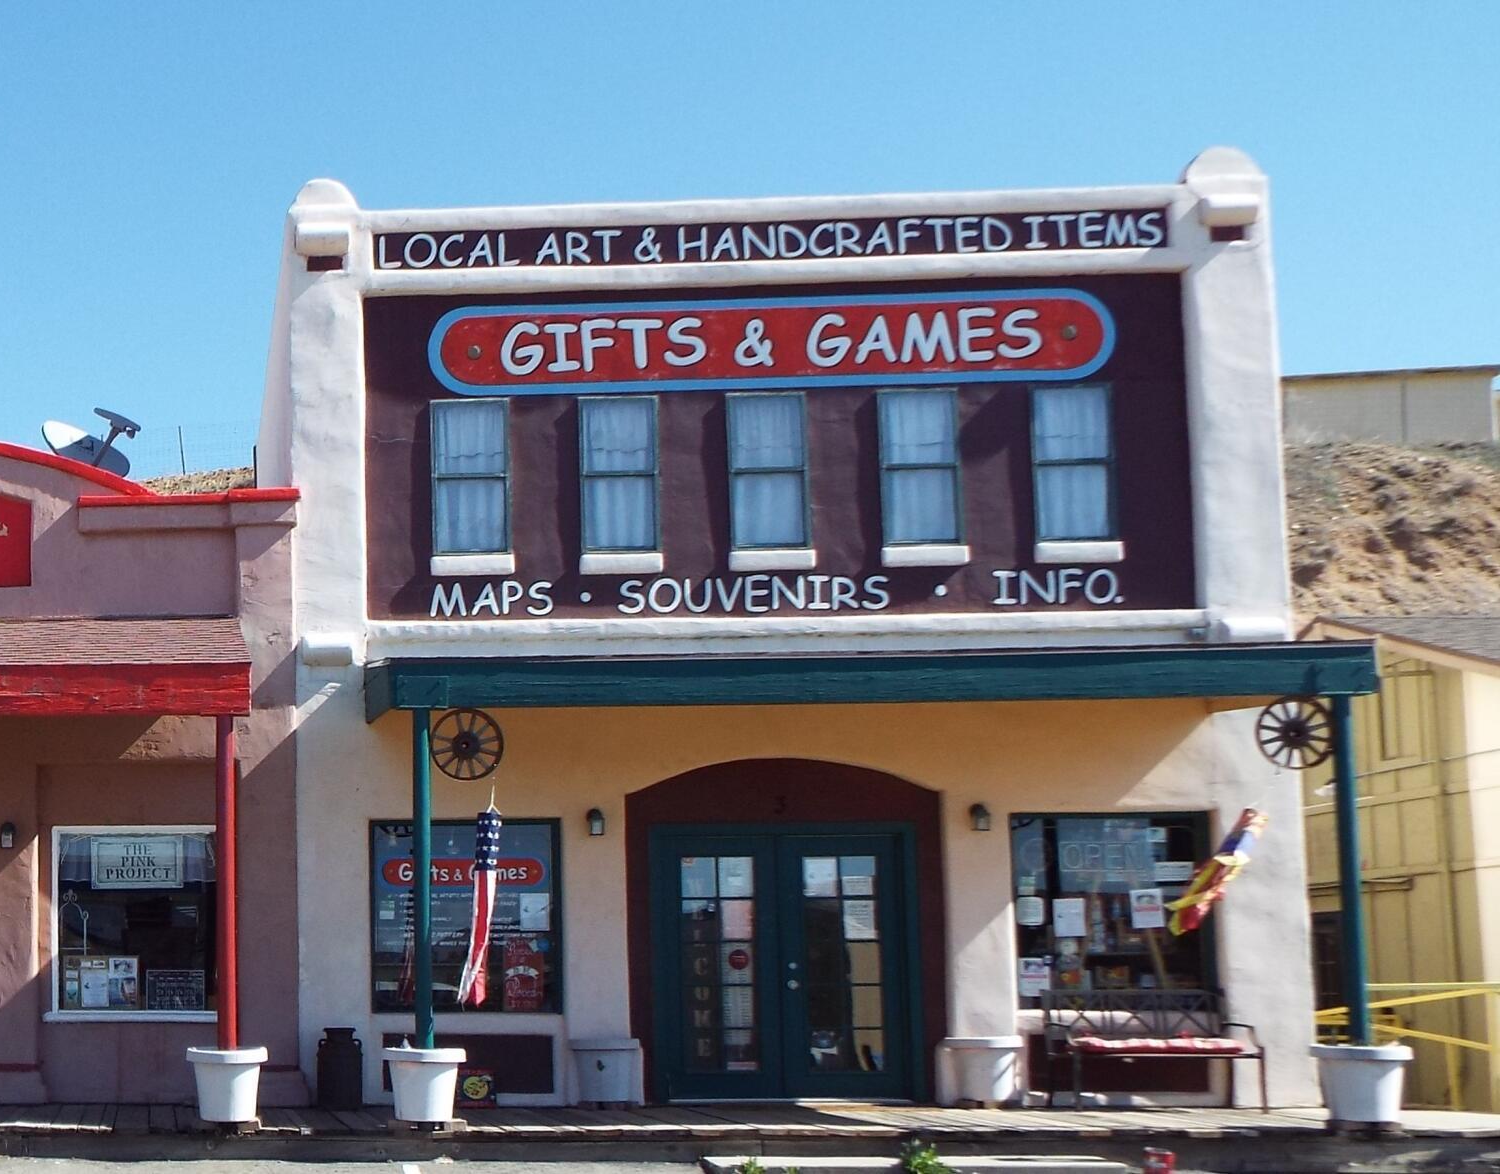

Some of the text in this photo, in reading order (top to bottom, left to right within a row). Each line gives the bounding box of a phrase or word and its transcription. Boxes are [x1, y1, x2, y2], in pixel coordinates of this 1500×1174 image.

[377, 210, 1165, 270] LOCAL ART & HANDCRAFTED ITEMS
[499, 307, 1044, 377] GIFTS & GAMES
[429, 568, 1126, 618] MAPS SOUVENIRS INFO.
[123, 844, 152, 857] THE
[1063, 843, 1144, 869] OPEN
[120, 856, 157, 868] PINK
[397, 863, 450, 882] Gts
[453, 867, 464, 882] &
[105, 867, 173, 880] PROJECT
